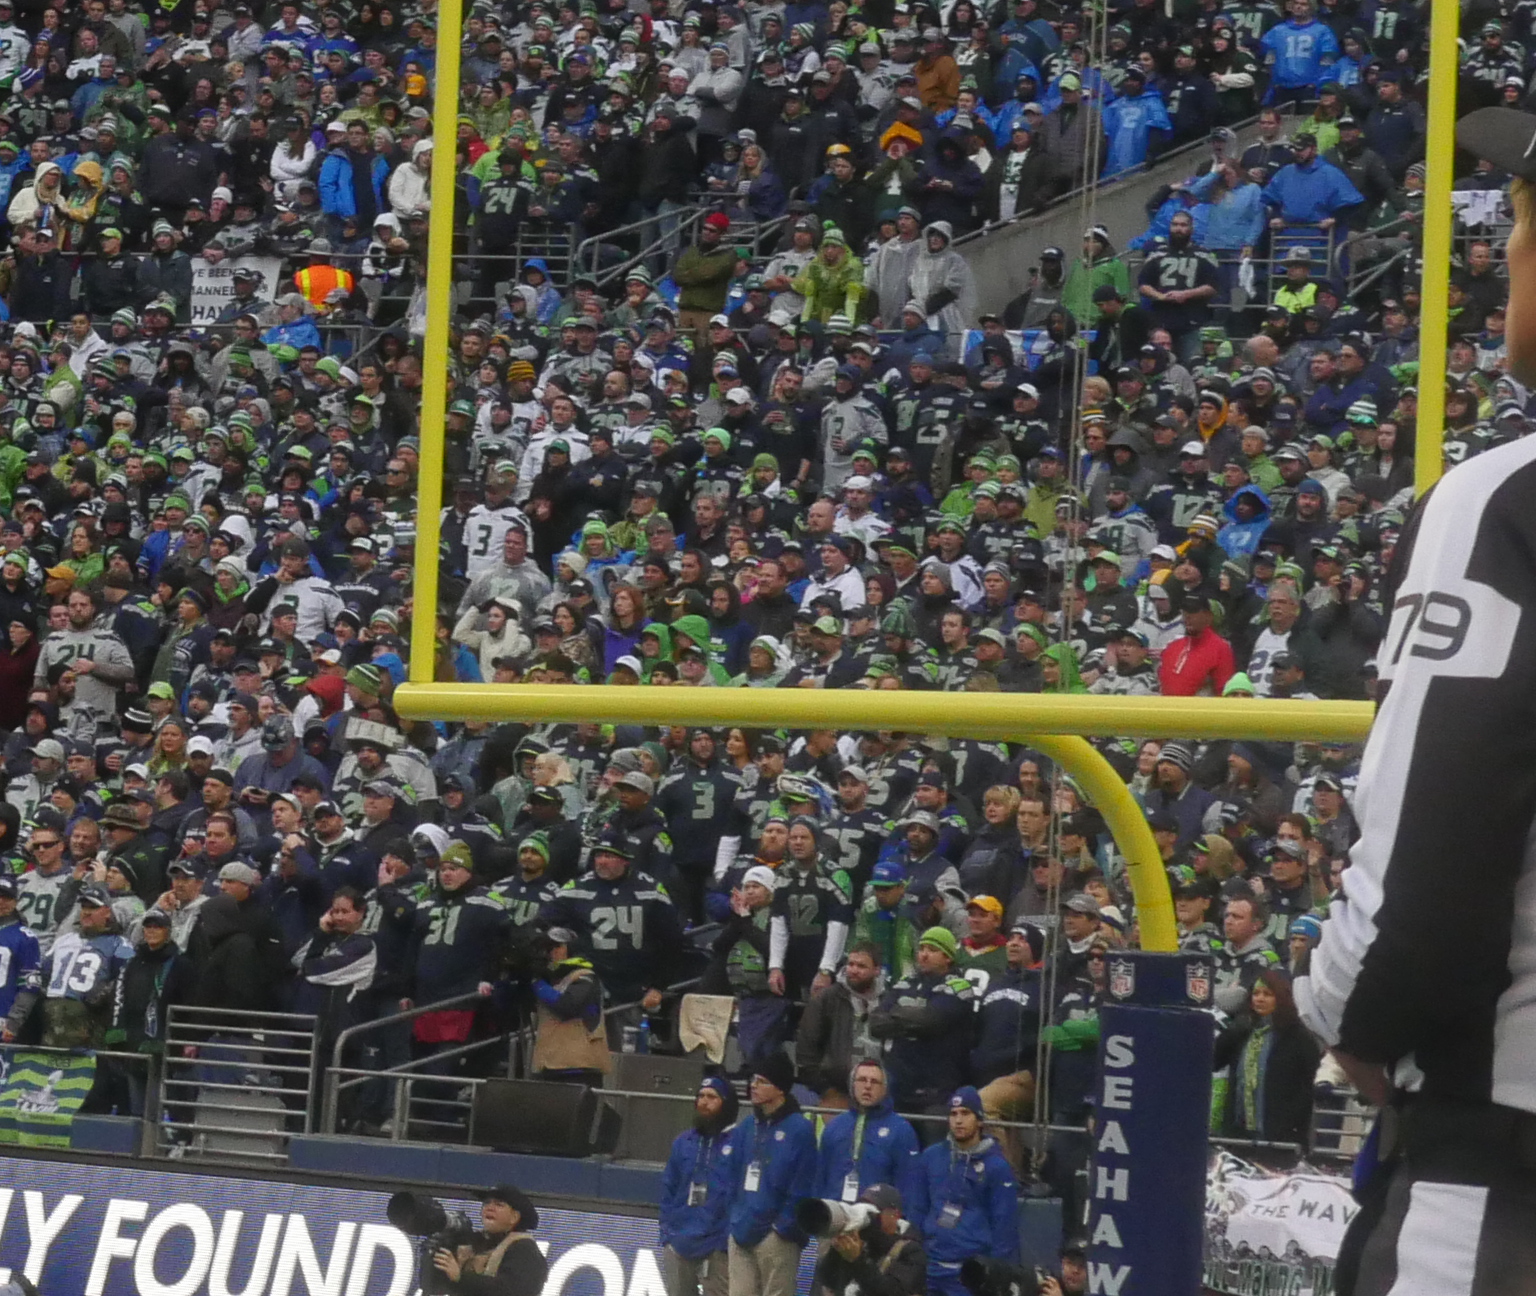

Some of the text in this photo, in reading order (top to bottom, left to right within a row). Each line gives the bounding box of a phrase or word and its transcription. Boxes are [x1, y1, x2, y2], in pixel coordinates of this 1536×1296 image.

[1284, 34, 1314, 59] 12
[484, 187, 518, 215] 24
[1159, 257, 1198, 288] 24
[1171, 493, 1206, 528] 12
[473, 523, 493, 557] 3
[1390, 591, 1473, 665] 79
[56, 643, 96, 667] 24
[951, 749, 969, 787] 7
[691, 781, 715, 820] 3
[16, 890, 53, 931] 29
[424, 905, 463, 946] 31
[589, 905, 644, 951] 24
[788, 894, 822, 935] 12
[47, 944, 102, 999] 13
[1252, 1204, 1291, 1219] THE
